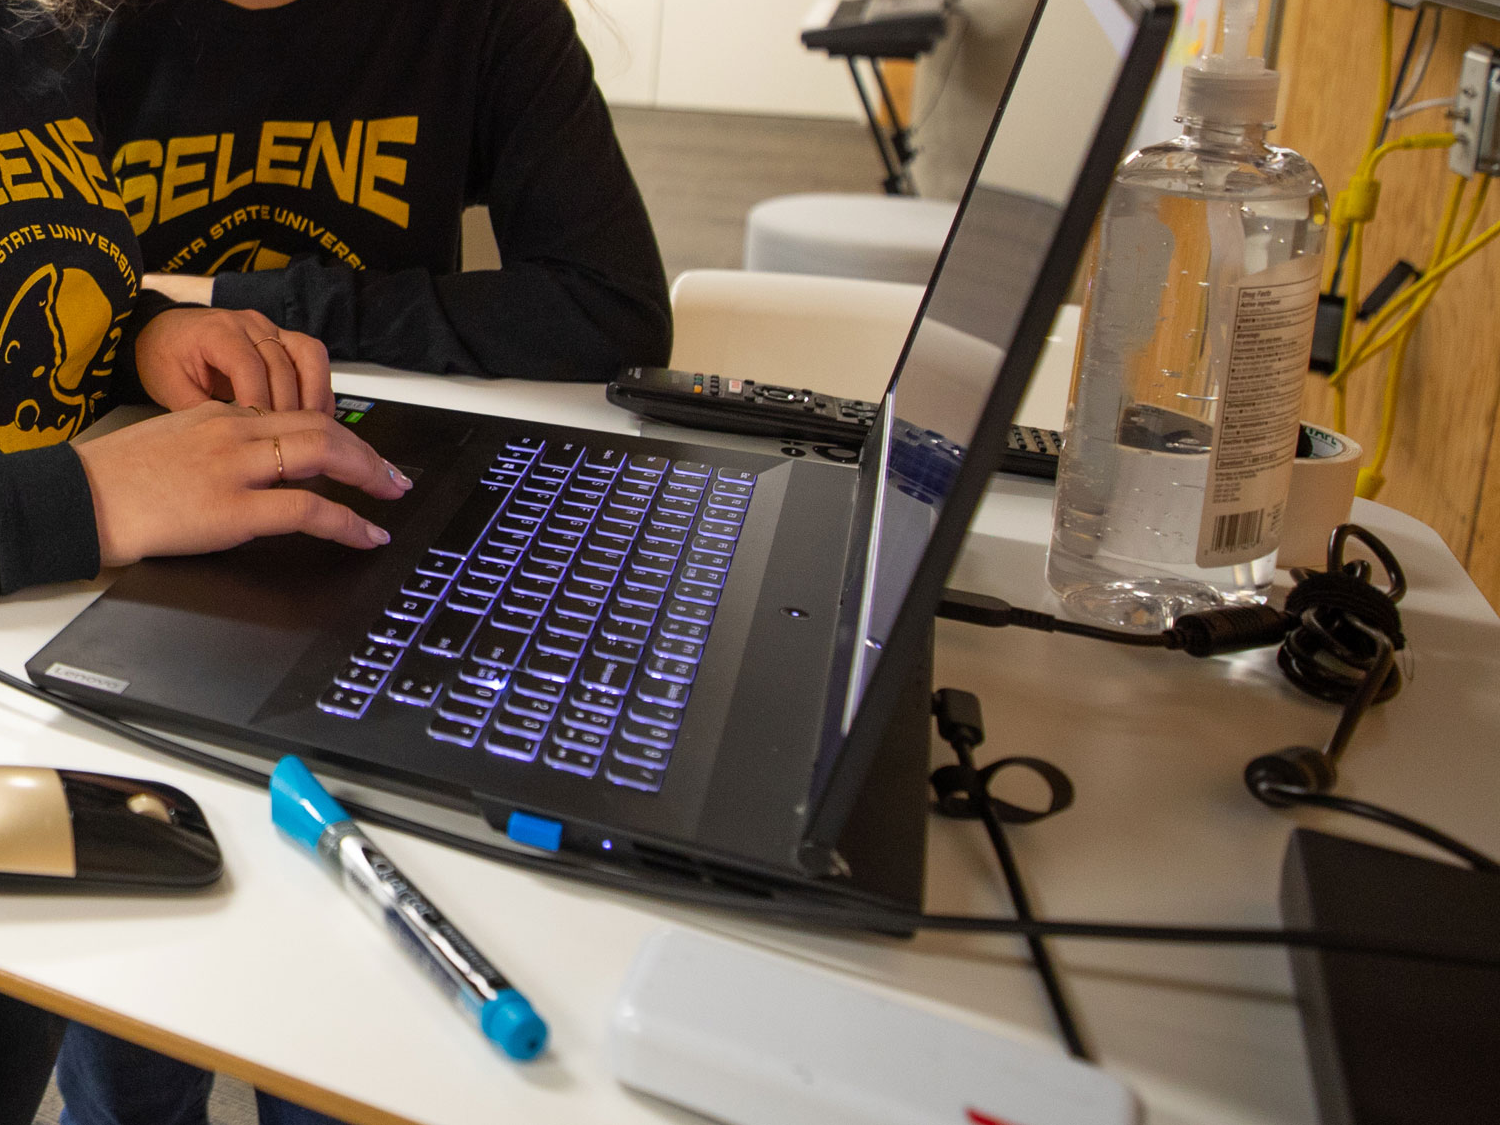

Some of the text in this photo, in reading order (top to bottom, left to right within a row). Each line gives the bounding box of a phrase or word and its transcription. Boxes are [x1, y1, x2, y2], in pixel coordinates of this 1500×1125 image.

[112, 116, 419, 237] SELENE
[47, 224, 138, 299] UNIVERSITY
[161, 205, 366, 274] HITA STATE UNIVERS
